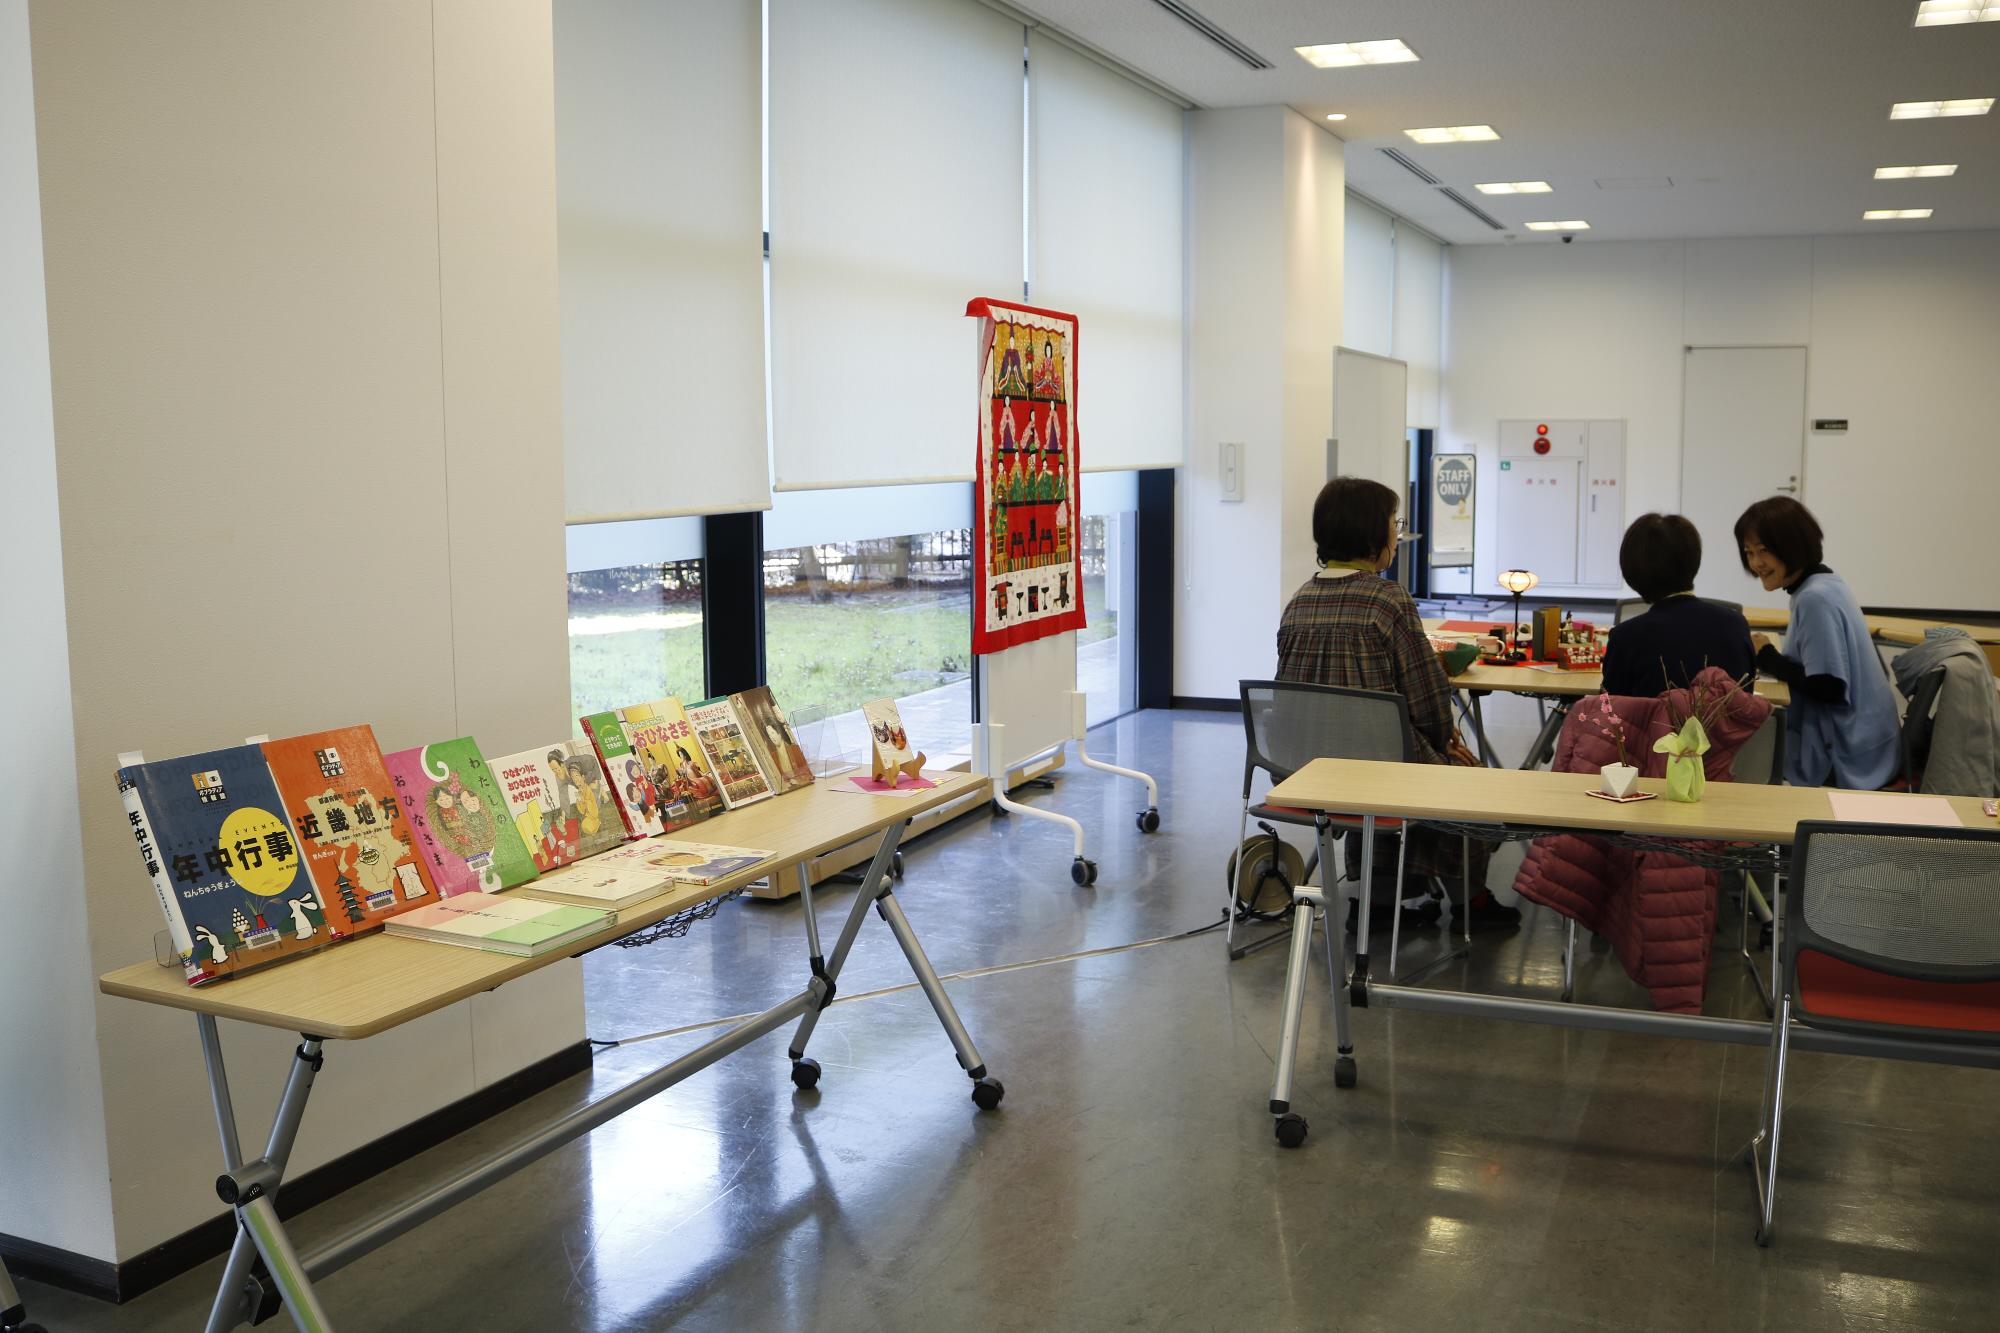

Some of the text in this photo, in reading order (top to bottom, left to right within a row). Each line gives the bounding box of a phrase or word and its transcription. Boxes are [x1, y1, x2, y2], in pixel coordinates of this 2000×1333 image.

[1438, 470, 1470, 482] STAFF
[1439, 483, 1468, 496] ONLY
[633, 719, 690, 748] おひなさま
[502, 764, 537, 779] ひなまつりに
[507, 775, 541, 791] おひなさまを
[468, 758, 507, 825] わたしの
[511, 787, 541, 803] かざるわけ
[296, 796, 400, 840] 近畿地方
[393, 775, 445, 867] おひなさま
[128, 810, 161, 878] 年中行事
[171, 830, 294, 884] 年中行事
